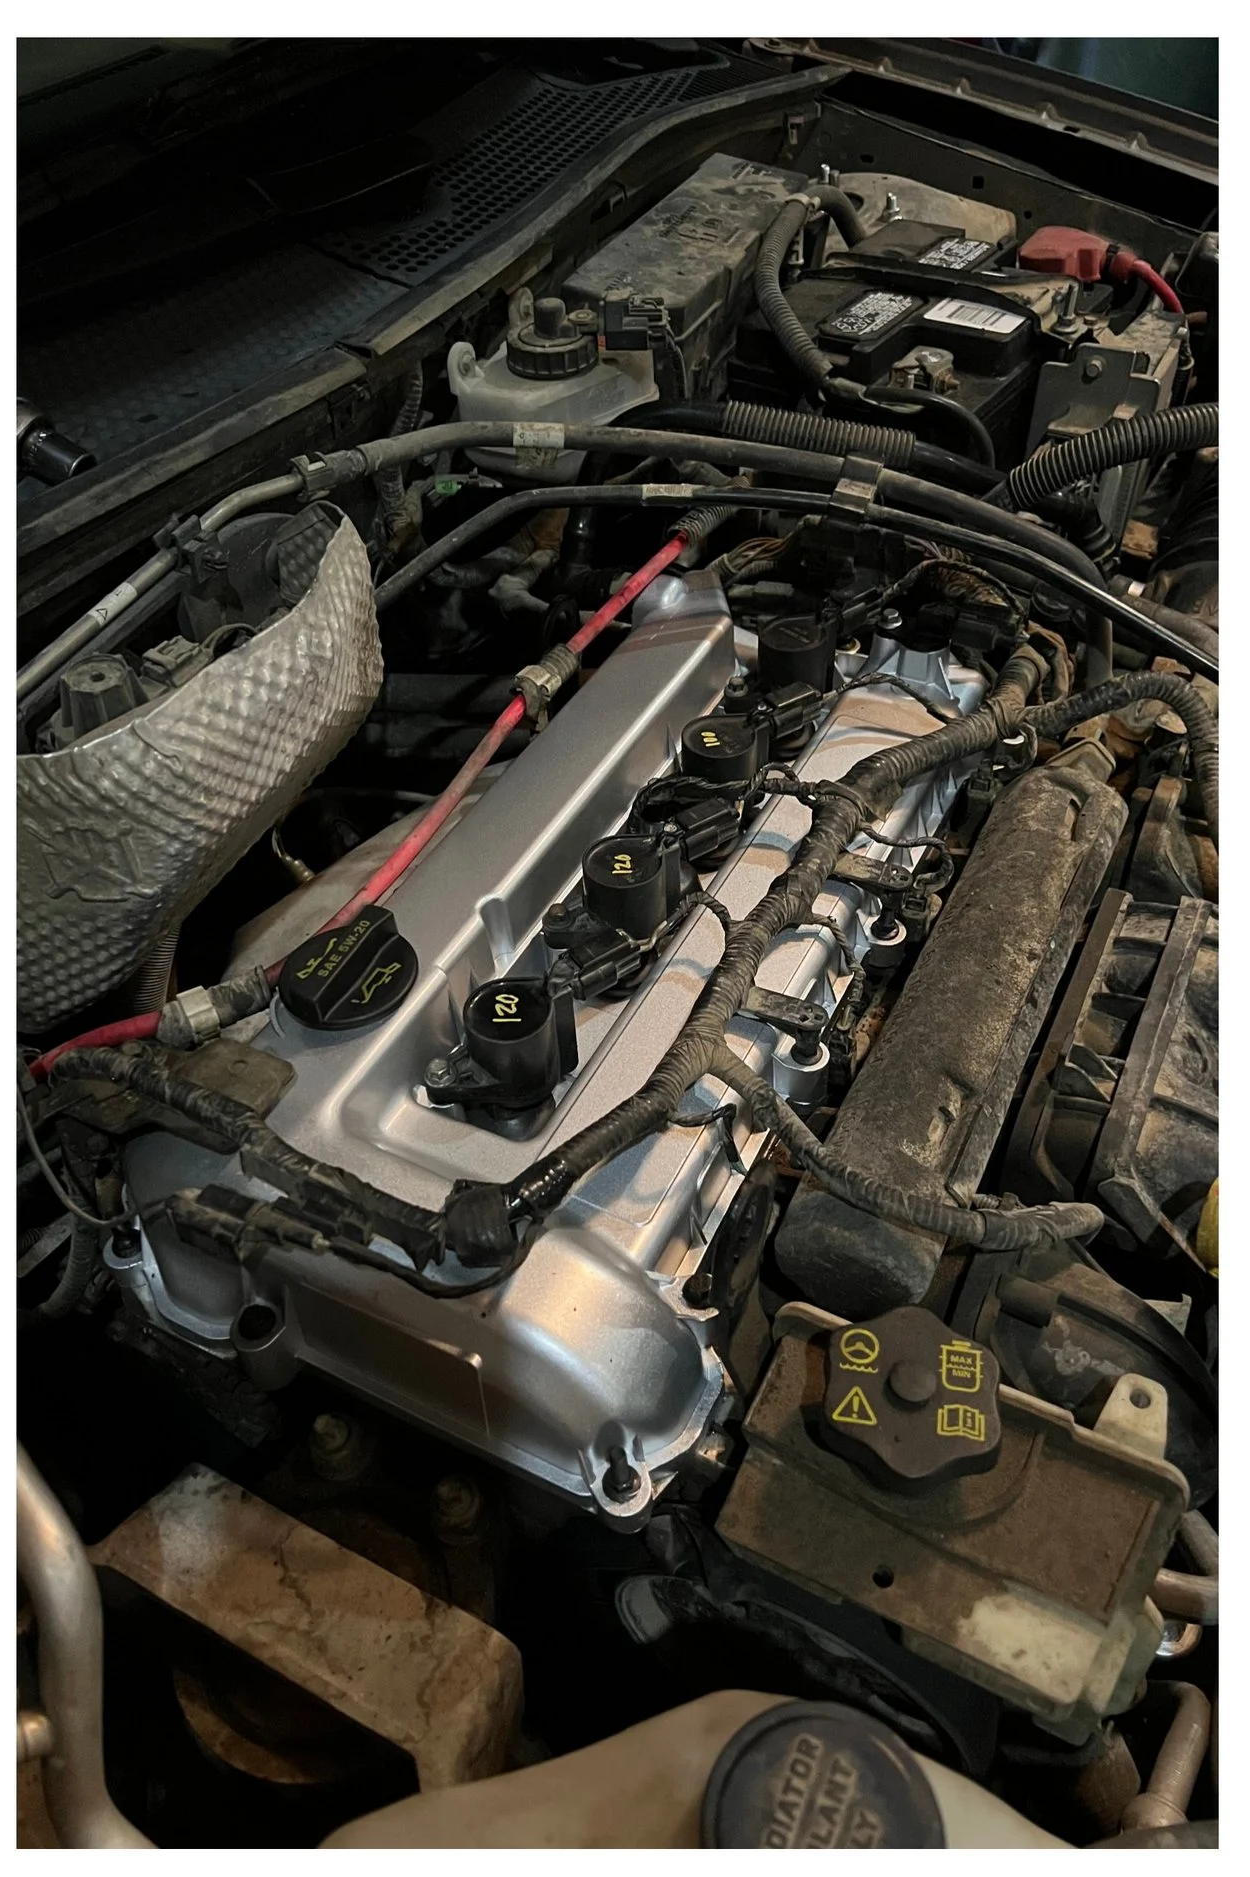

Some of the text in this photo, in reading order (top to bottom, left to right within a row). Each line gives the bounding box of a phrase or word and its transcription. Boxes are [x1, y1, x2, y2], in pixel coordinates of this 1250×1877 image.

[611, 853, 633, 875] 120
[317, 920, 371, 977] SAE 5W-20
[491, 994, 522, 1023] 120
[950, 1354, 973, 1365] MAX
[952, 1369, 971, 1378] MIN
